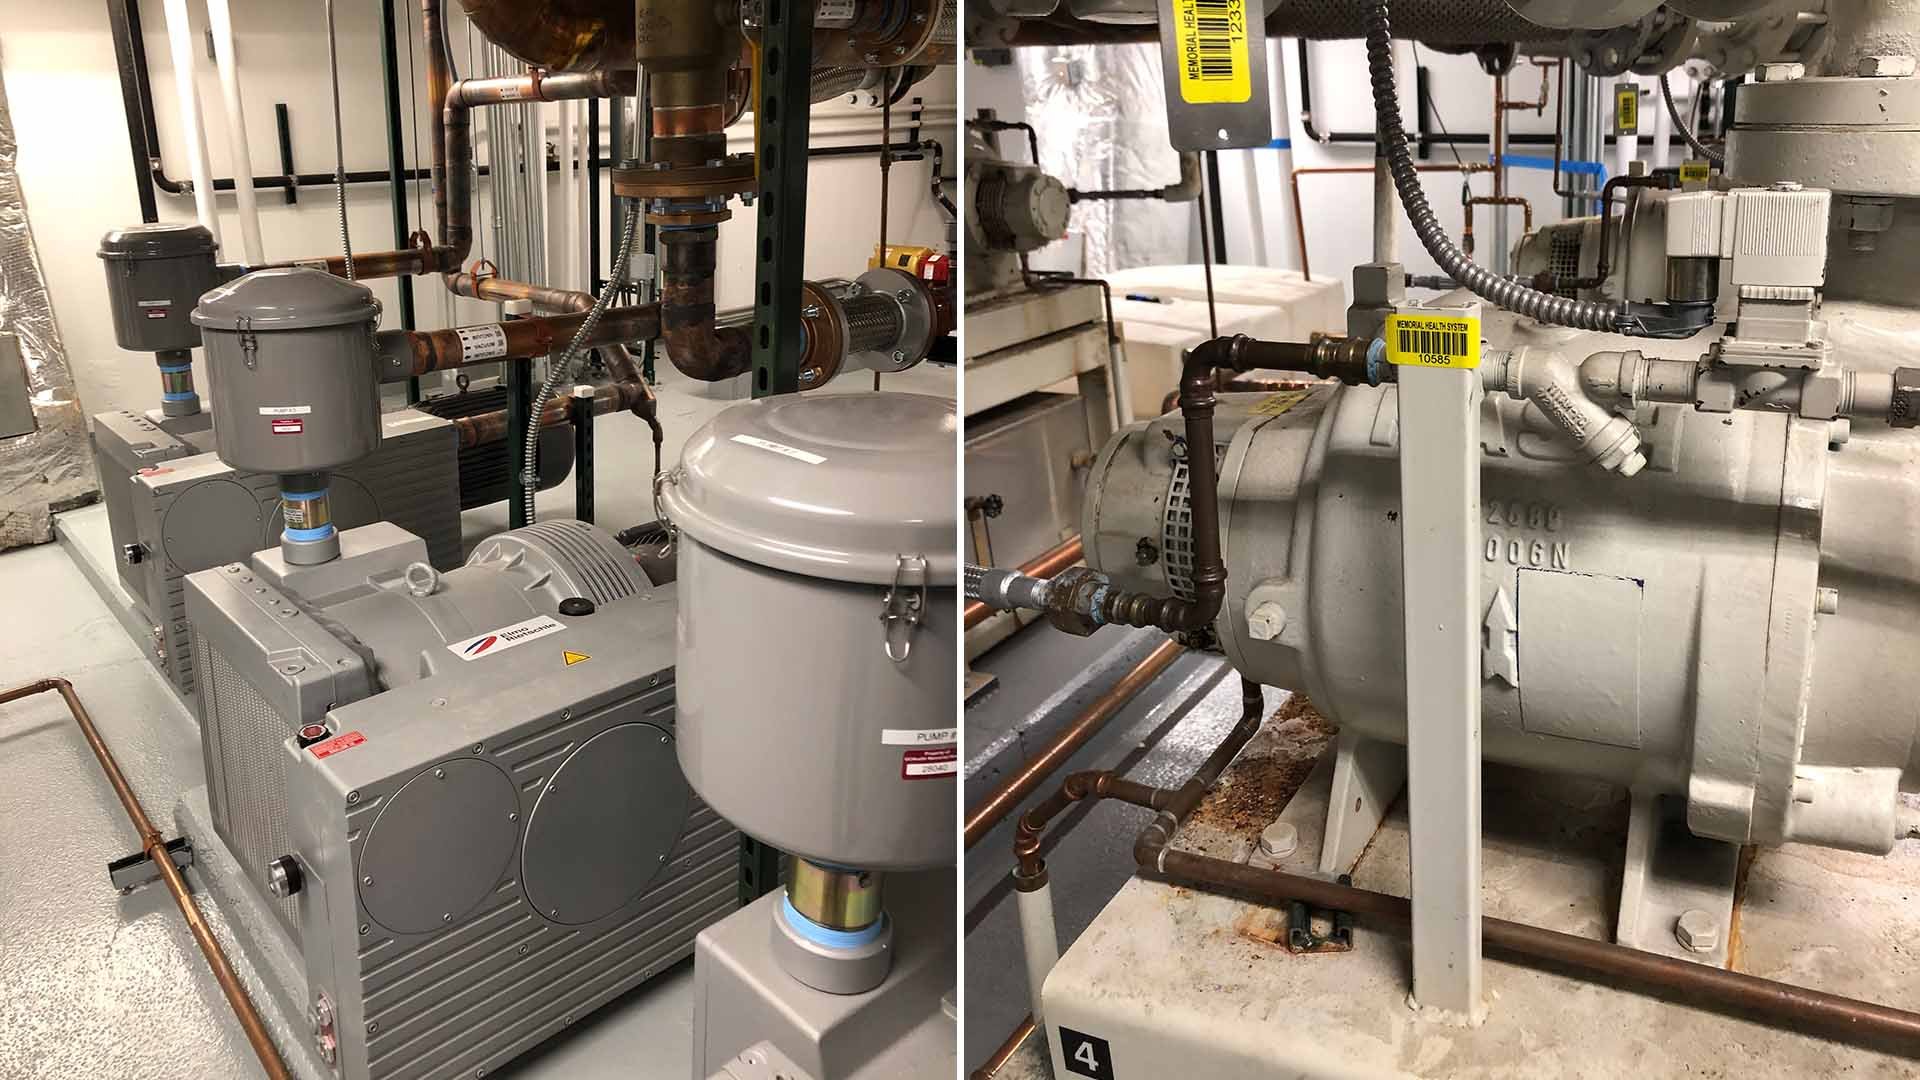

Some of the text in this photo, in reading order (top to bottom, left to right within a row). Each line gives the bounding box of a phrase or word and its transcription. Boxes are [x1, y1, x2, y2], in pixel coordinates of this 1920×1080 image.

[1183, 0, 1200, 80] MEMORIAL HEAL
[1397, 319, 1468, 331] MEMORIAL HEALTH SYSTEM
[1418, 354, 1451, 364] 10585
[500, 627, 529, 639] Elmo
[505, 623, 556, 642] Rietschle
[917, 731, 949, 742] PUMP
[1074, 1040, 1099, 1072] 4
